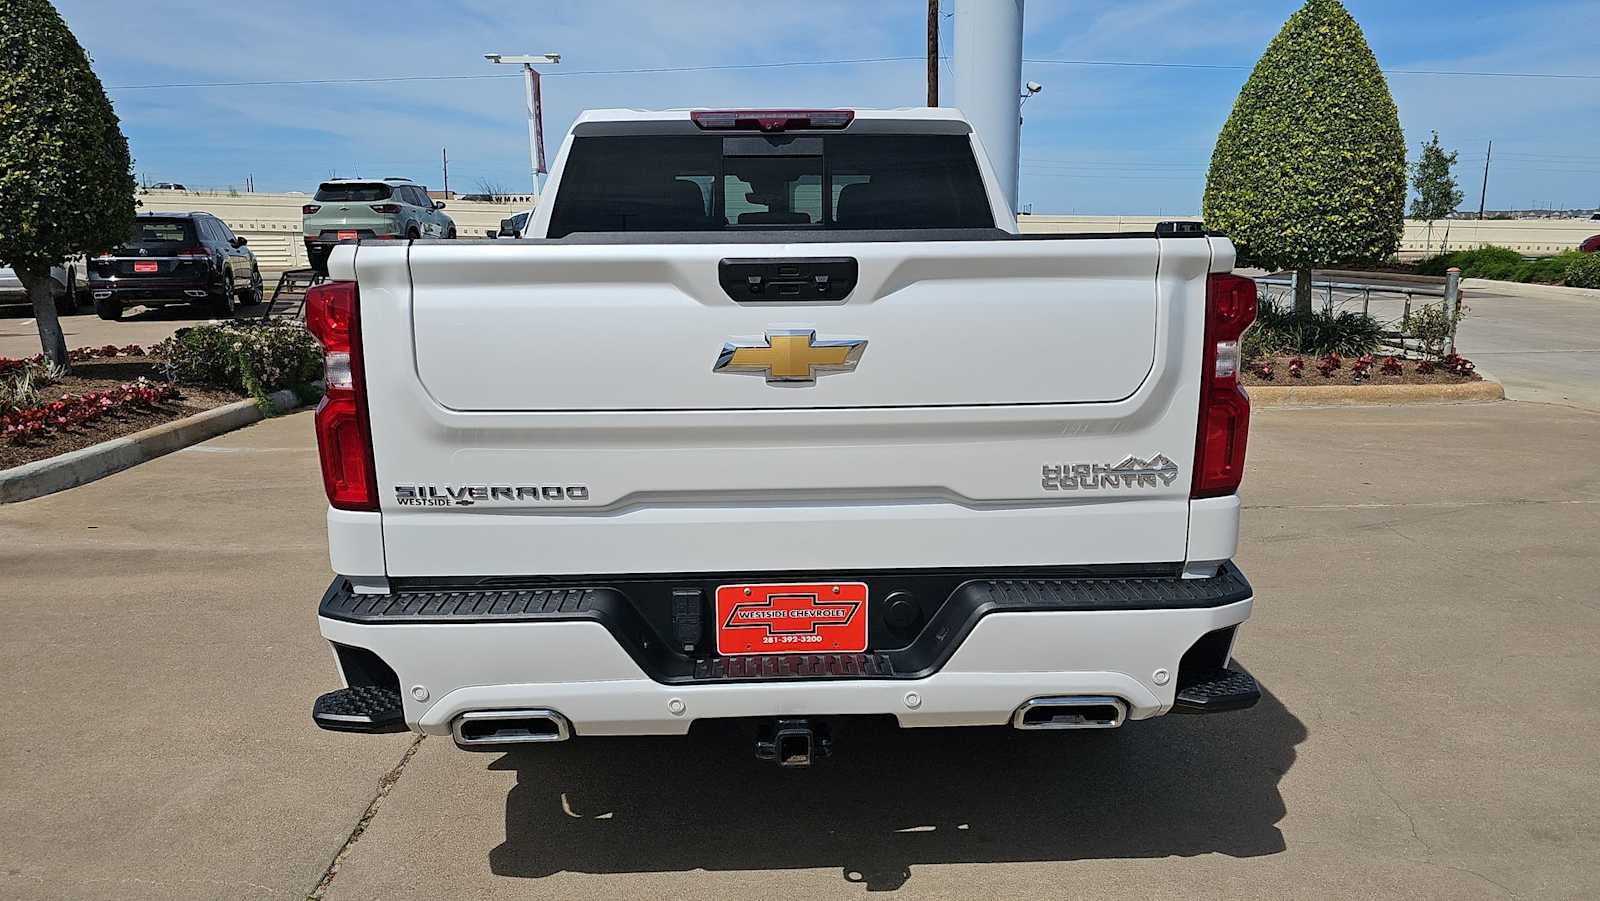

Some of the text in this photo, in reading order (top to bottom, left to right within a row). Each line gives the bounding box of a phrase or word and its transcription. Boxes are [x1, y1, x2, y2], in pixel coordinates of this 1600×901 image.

[1041, 463, 1112, 476] HIGH
[1041, 472, 1178, 491] COUNTRY
[395, 486, 590, 501] SILVERADO
[397, 498, 451, 507] WESTSIDE
[739, 608, 846, 620] WESTSIDE CHEVROLET
[762, 635, 823, 644] 281-392-3200
